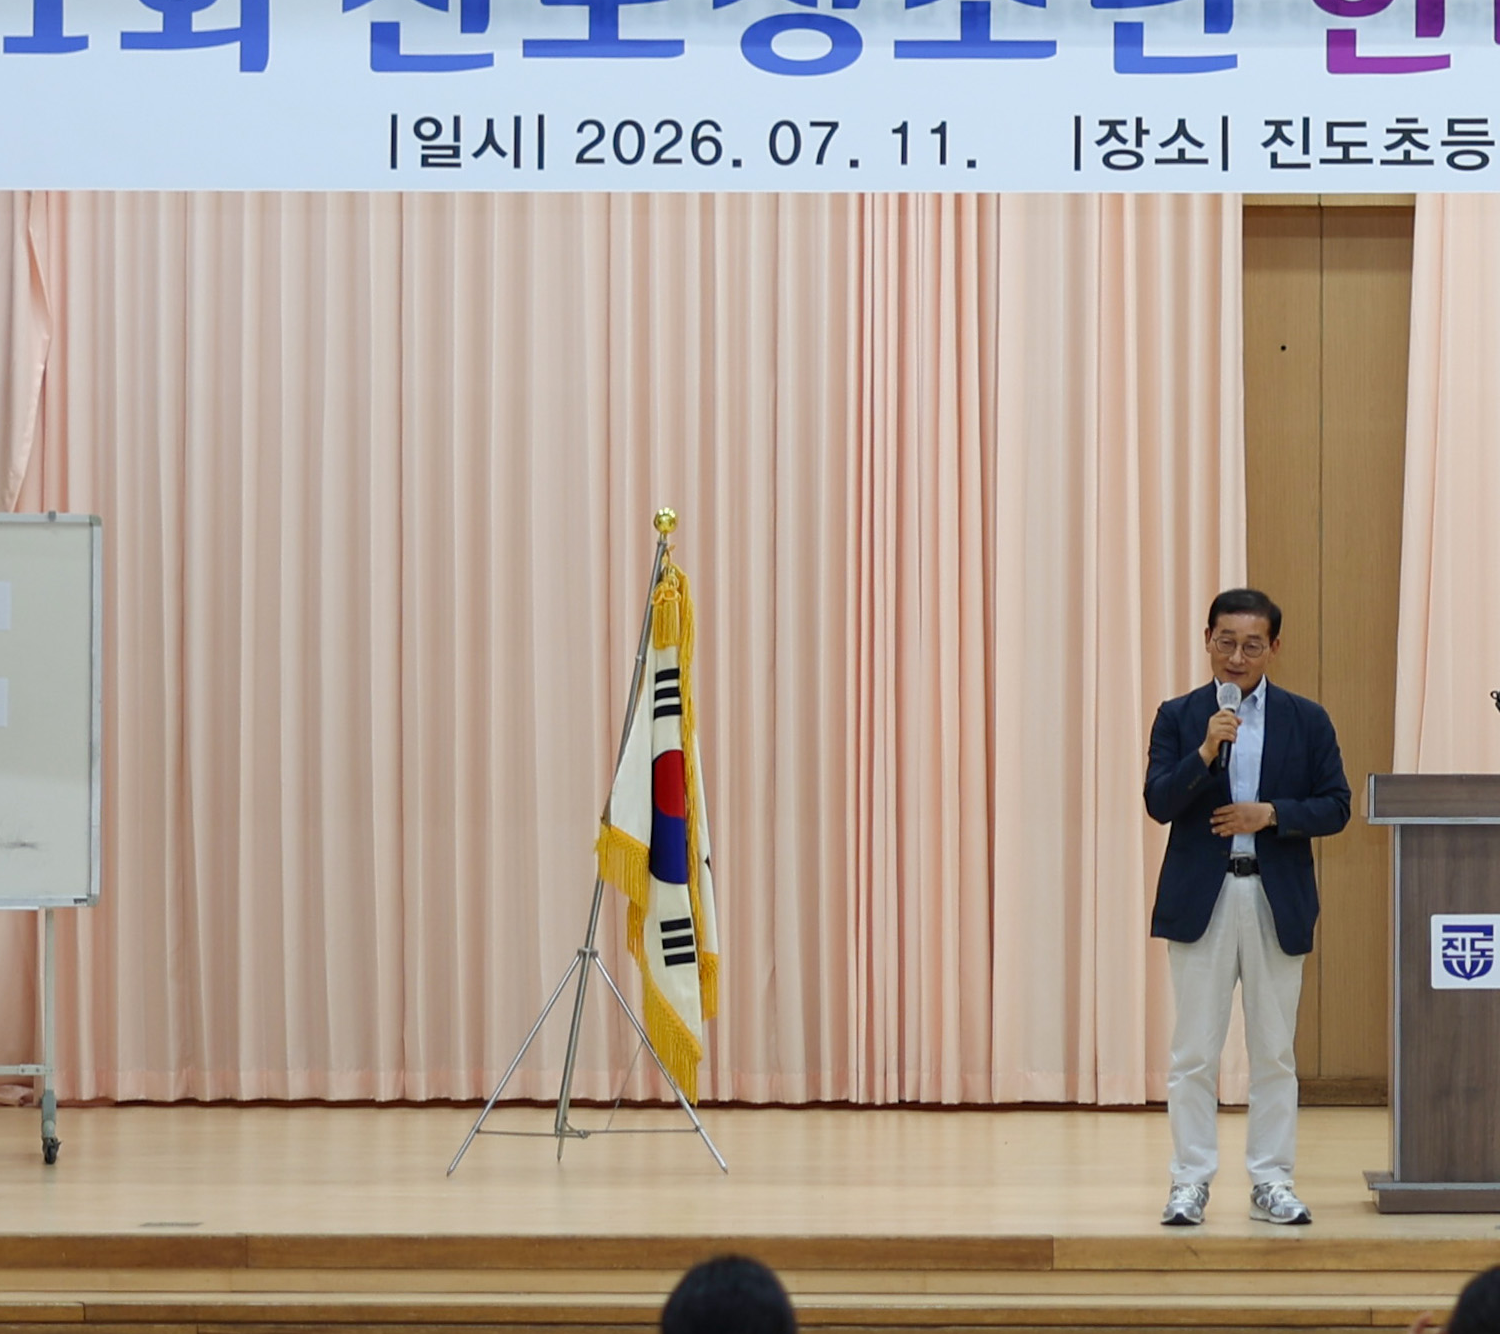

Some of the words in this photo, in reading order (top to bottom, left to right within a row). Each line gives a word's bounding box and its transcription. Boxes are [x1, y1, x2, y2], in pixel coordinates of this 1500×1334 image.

[575, 119, 742, 168] 2026.
[769, 120, 859, 168] 07.
[892, 120, 976, 168] 11.
